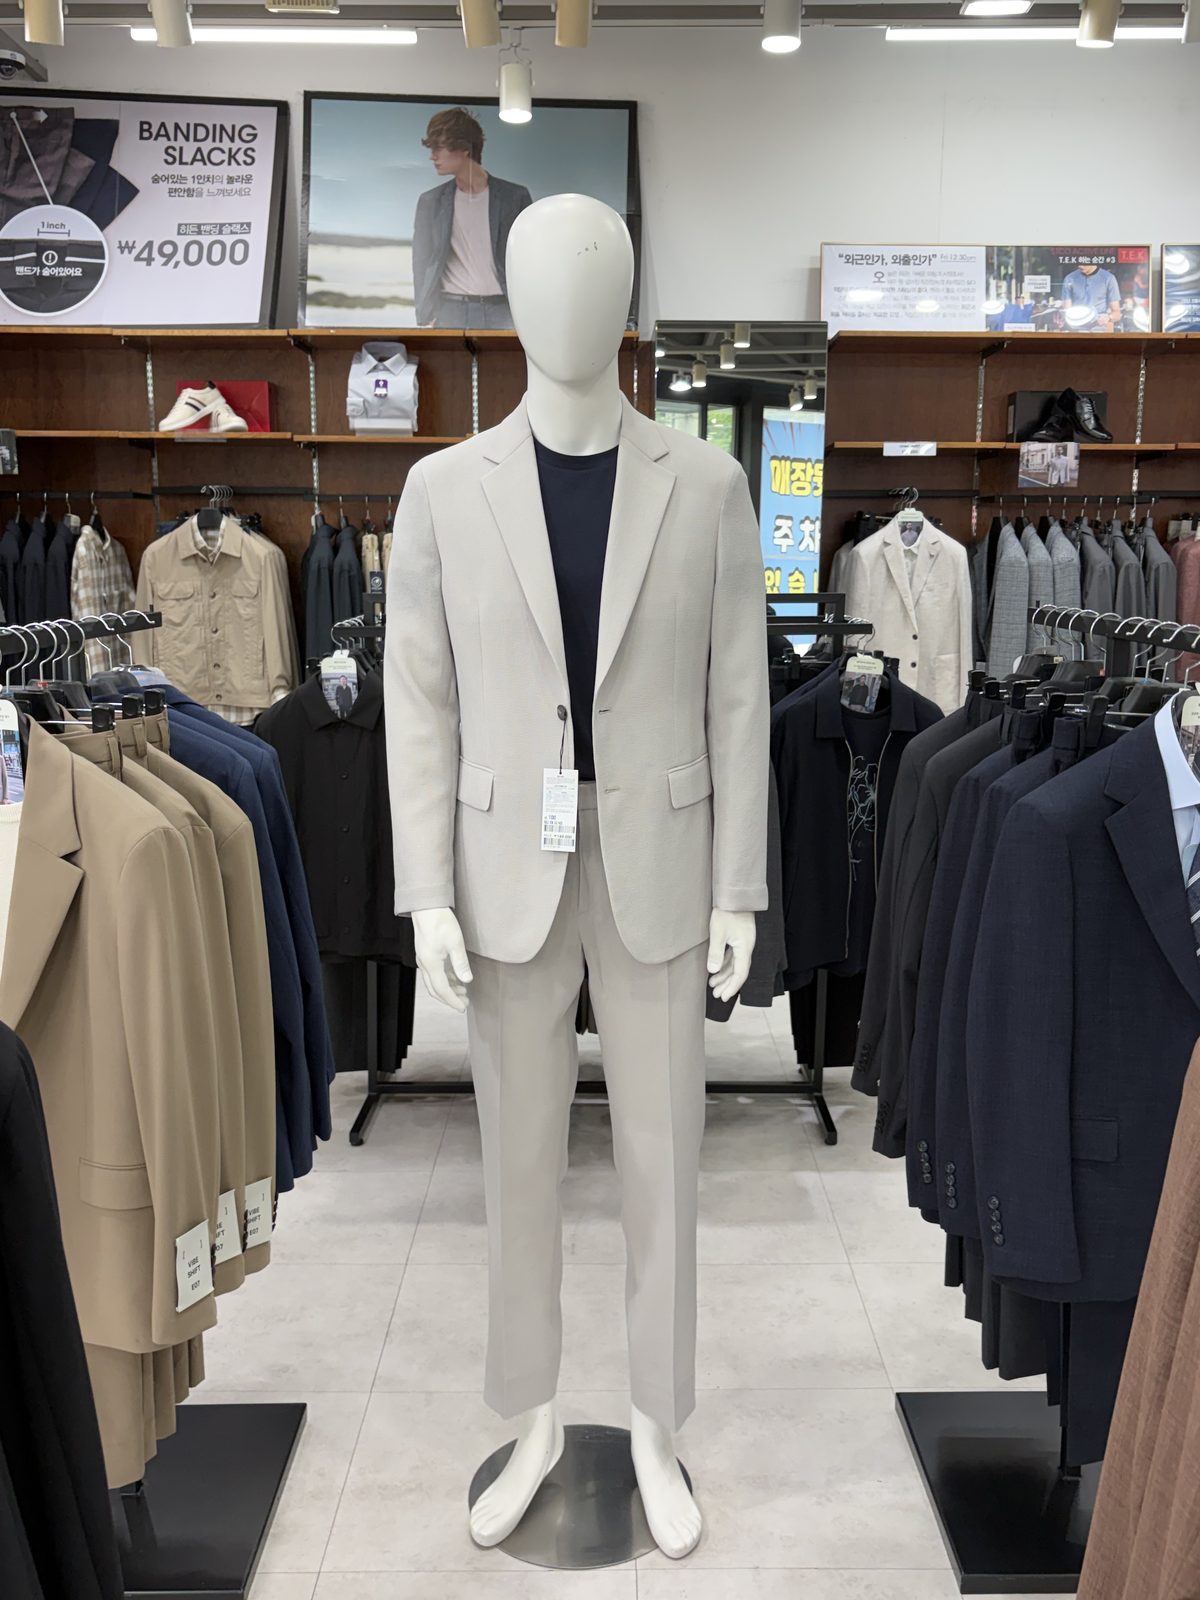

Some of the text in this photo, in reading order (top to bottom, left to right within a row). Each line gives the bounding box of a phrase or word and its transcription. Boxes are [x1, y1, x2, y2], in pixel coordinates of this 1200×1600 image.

[139, 121, 258, 143] BANDING
[163, 145, 256, 166] SLACKS
[151, 174, 253, 185] 숨어있는 1인치의 놀라운
[168, 187, 252, 198] 편안함을 느껴보세요
[200, 224, 220, 235] 밴딩
[221, 223, 250, 234] 슬랙스
[117, 239, 250, 269] ₩49,000
[1121, 251, 1146, 261] T.E.K
[1058, 256, 1077, 264] T.E.K
[15, 266, 83, 277] 밴드가 숨어있어요
[873, 271, 886, 284] 오
[248, 1207, 260, 1215] VIBE
[188, 1256, 199, 1267] VIBE
[187, 1264, 201, 1279] SHIFT
